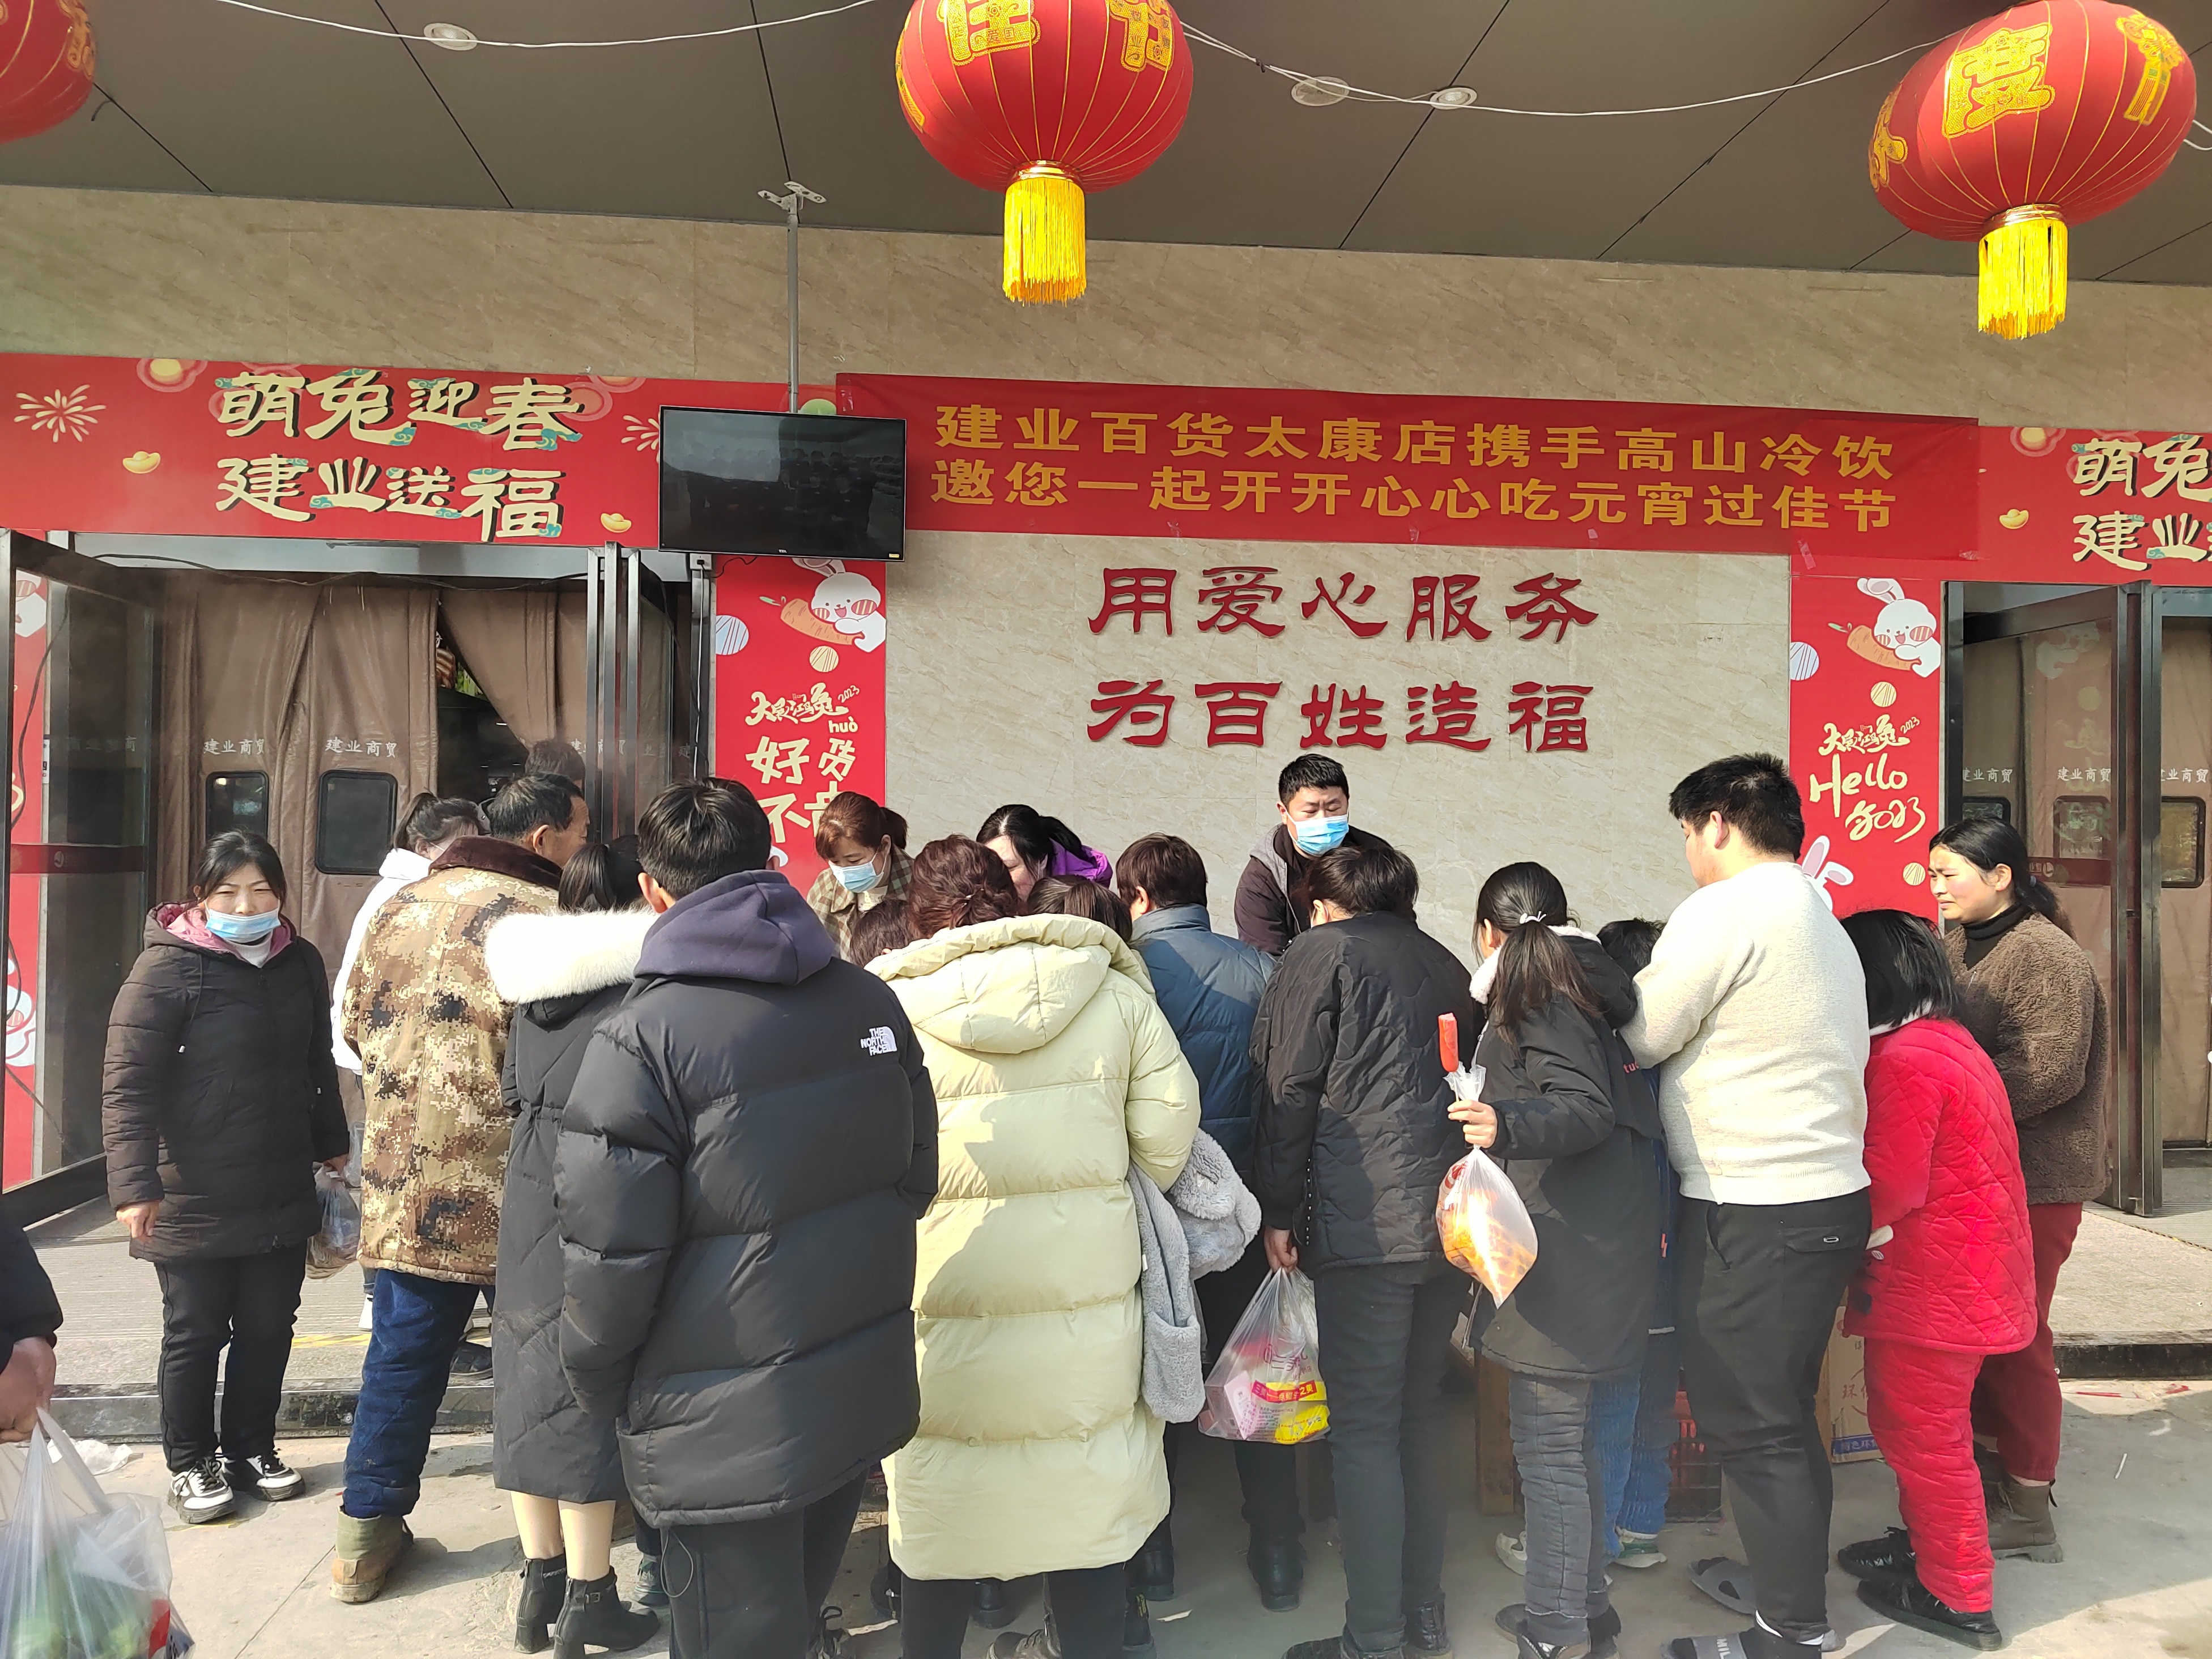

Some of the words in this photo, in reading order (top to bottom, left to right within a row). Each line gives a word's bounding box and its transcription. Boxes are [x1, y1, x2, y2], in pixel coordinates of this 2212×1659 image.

[215, 368, 582, 451] 萌兔迎春
[935, 404, 1894, 480] 建业百货太康店携手高山冷饮
[216, 454, 563, 542] 建业送福
[930, 459, 1896, 532] 邀您一起开开心心吃元宵过佳节
[2071, 511, 2212, 571] 建业
[1088, 566, 1599, 643] 用爱心服务
[838, 685, 860, 703] 2023
[828, 716, 858, 733] huò
[1087, 679, 1593, 752] 为百姓造福
[1900, 716, 1920, 734] 2023
[203, 738, 265, 755] 建业商贸
[325, 736, 397, 758] 建业商贸
[1810, 753, 1908, 818] Hello
[2057, 767, 2111, 782] 建业商贸
[1845, 797, 1926, 843] 2023
[861, 1036, 884, 1048] NORTH
[869, 1027, 884, 1037] THE
[869, 1045, 887, 1056] FACE
